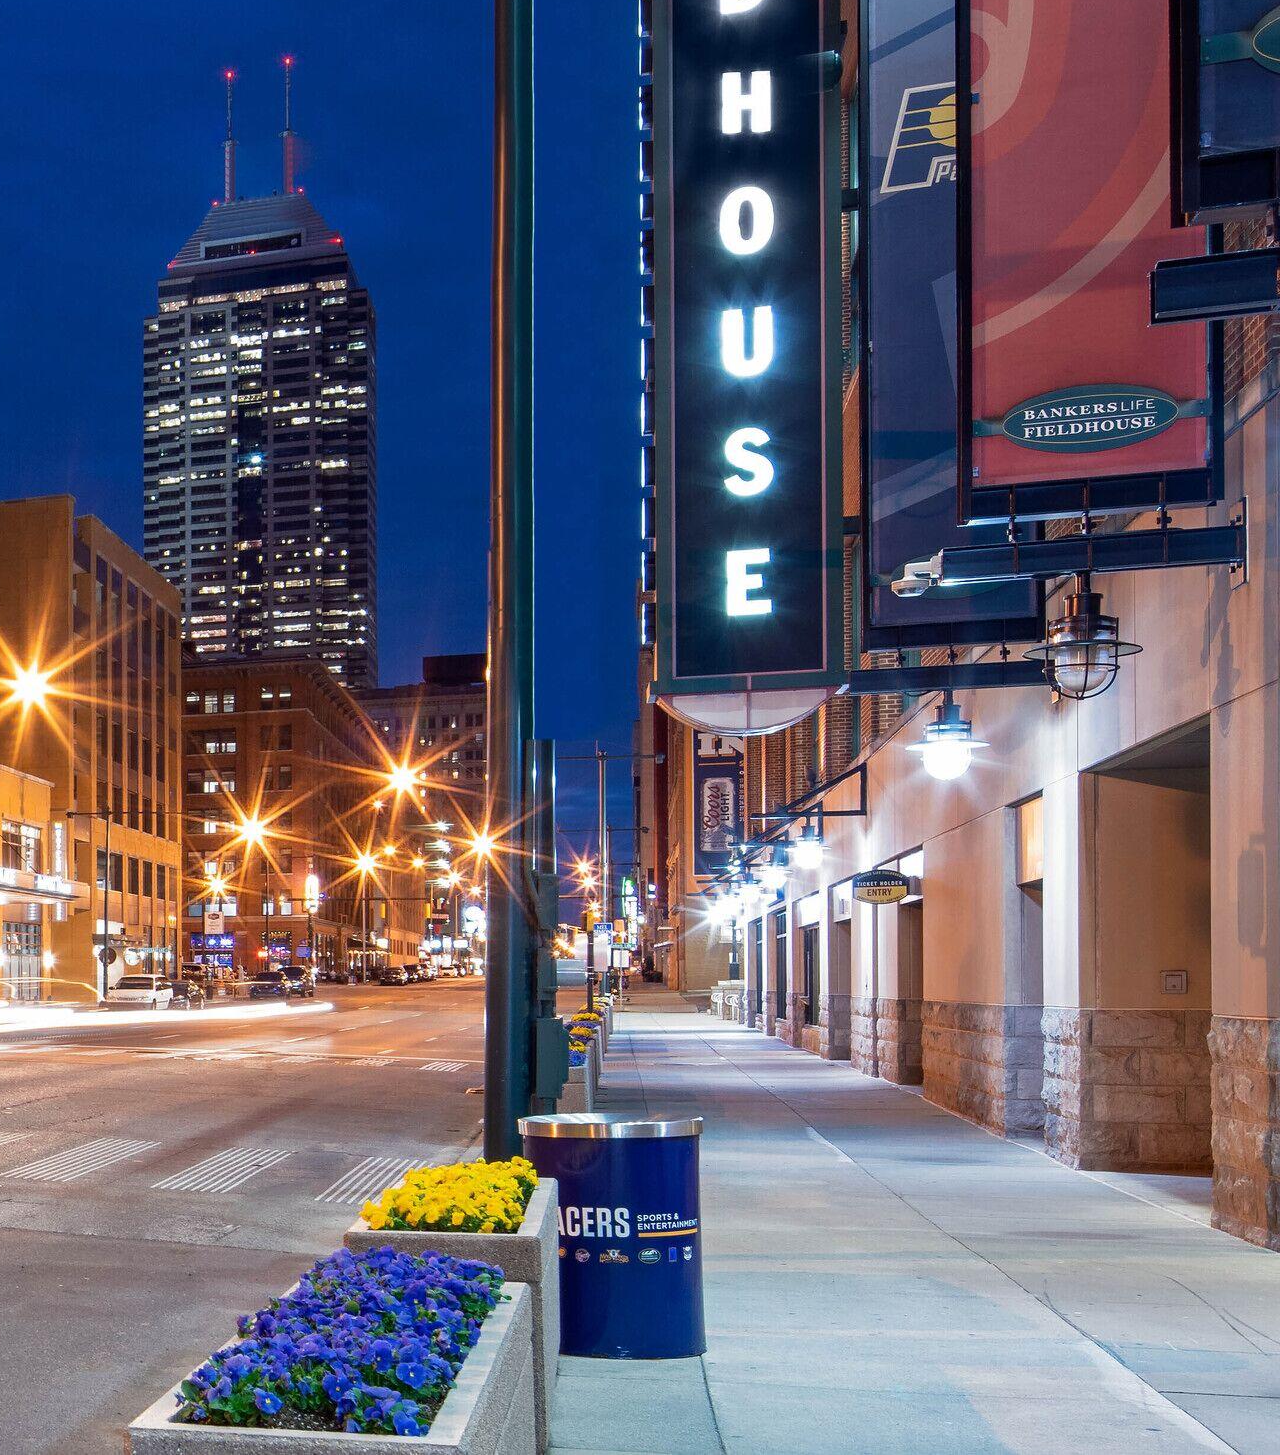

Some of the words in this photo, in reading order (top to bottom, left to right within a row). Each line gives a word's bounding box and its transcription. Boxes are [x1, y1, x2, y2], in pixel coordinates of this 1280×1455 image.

[1023, 402, 1118, 421] BANKERS
[1120, 398, 1156, 412] LIFE
[1023, 416, 1156, 439] FIELDHOUSE
[702, 785, 721, 831] Coors
[867, 888, 892, 896] ENTRY
[637, 1213, 672, 1222] SPORTS
[673, 1212, 680, 1221] &
[637, 1218, 699, 1231] ENTERTAINMENT
